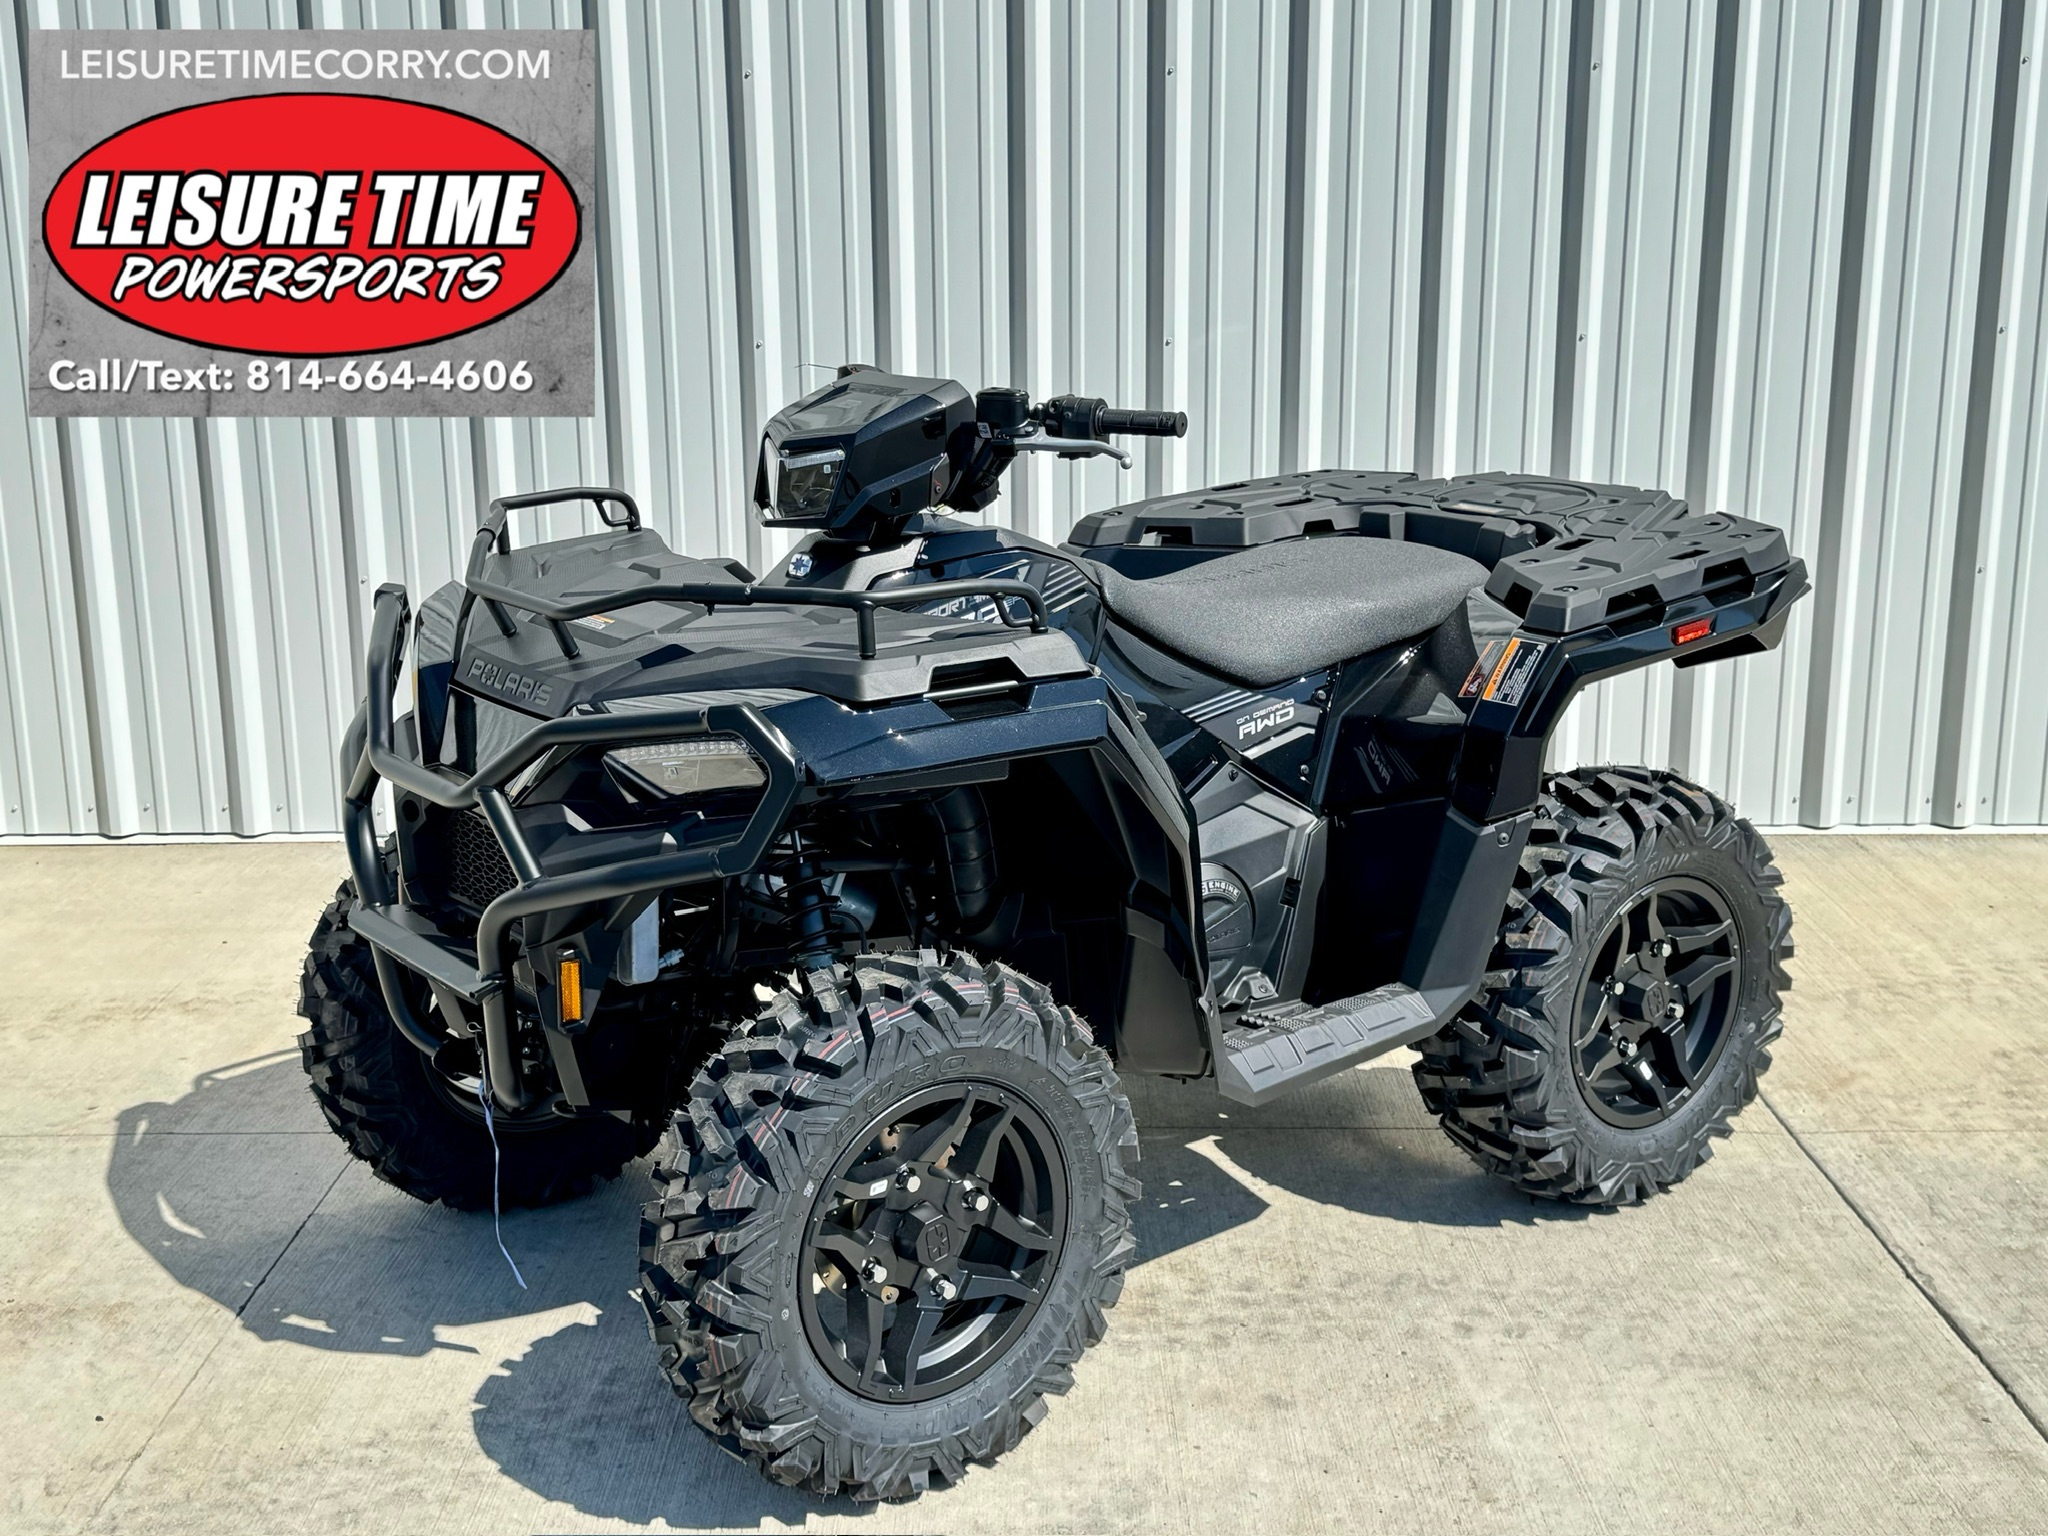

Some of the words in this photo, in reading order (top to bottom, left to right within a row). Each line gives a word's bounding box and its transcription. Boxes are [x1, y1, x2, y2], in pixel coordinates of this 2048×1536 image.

[467, 658, 553, 706] POLARIS
[1239, 706, 1295, 740] AWD
[826, 1056, 968, 1147] DURO
